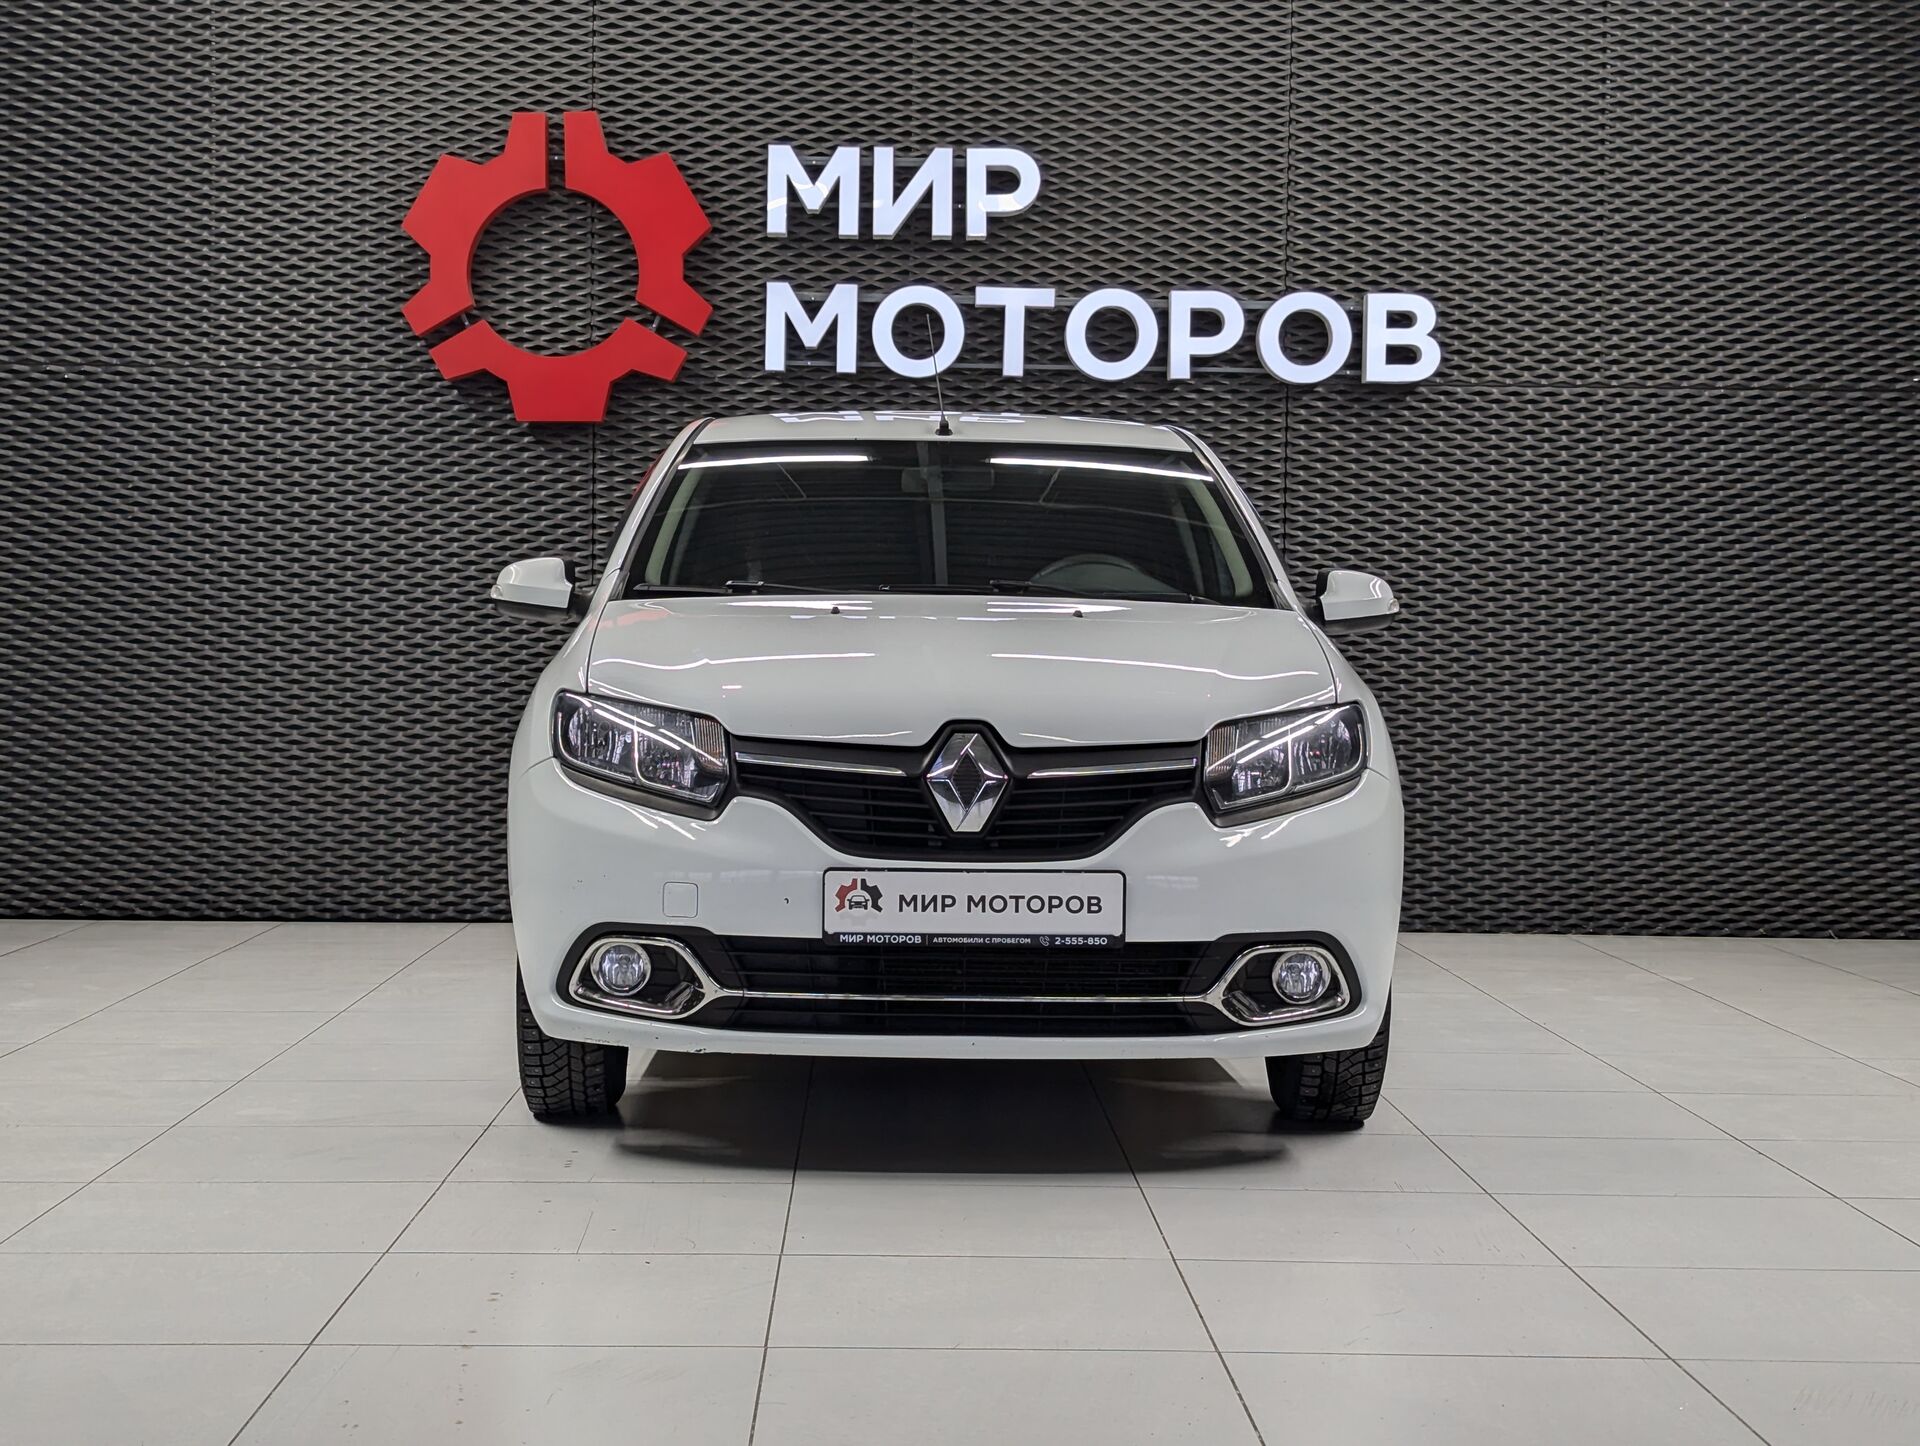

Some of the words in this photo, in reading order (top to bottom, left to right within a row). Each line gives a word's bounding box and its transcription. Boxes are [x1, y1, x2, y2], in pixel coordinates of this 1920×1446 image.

[766, 144, 1042, 240] МИР
[764, 282, 1443, 385] МОТОРОВ
[898, 894, 957, 913] МИР
[966, 894, 1103, 914] МОТОРОВ
[839, 934, 864, 944] МИР
[866, 934, 922, 944] МОТОРОВ
[991, 937, 1031, 945] ПРОБЕГОМ
[1054, 937, 1108, 946] 2-555-850
